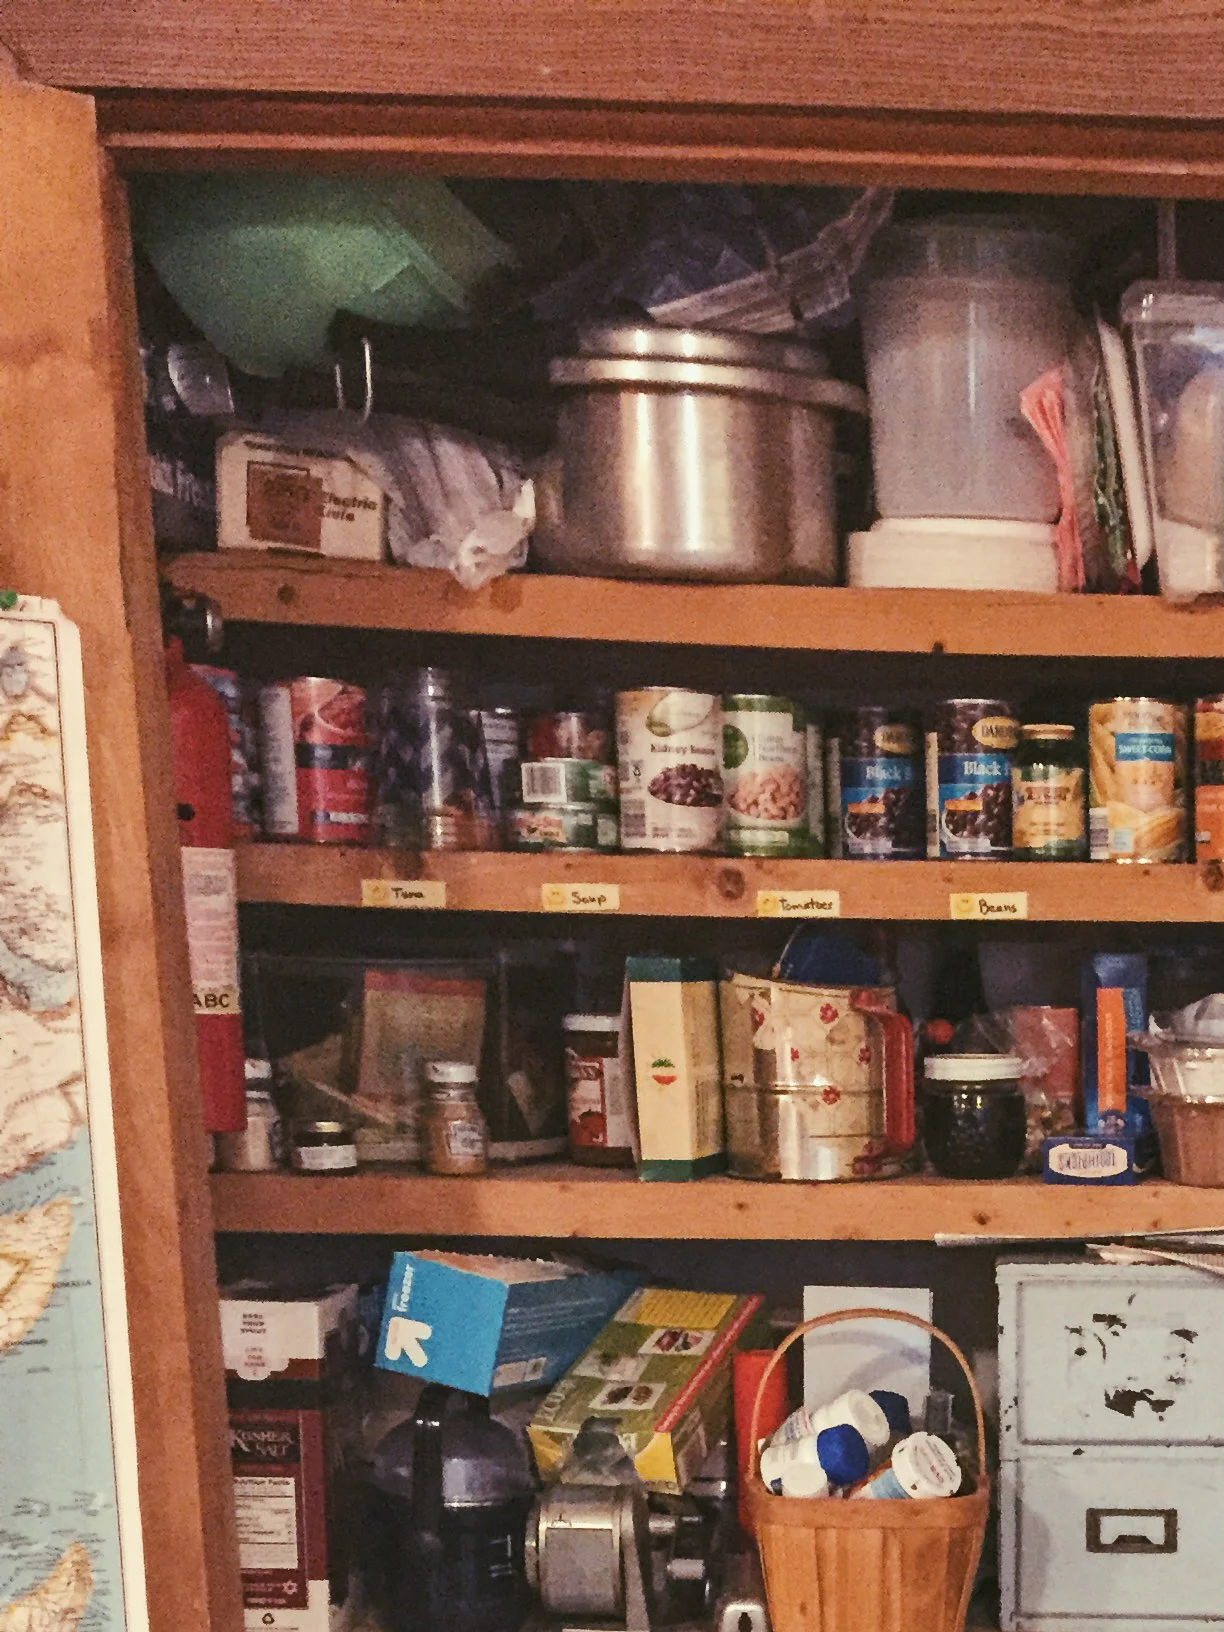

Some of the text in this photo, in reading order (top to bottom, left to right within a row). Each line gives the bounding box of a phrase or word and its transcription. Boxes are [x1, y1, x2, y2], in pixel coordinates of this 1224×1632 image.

[963, 759, 1001, 776] Black
[571, 891, 607, 907] Soup
[779, 896, 833, 911] Tomatoes
[979, 898, 1018, 915] Beans
